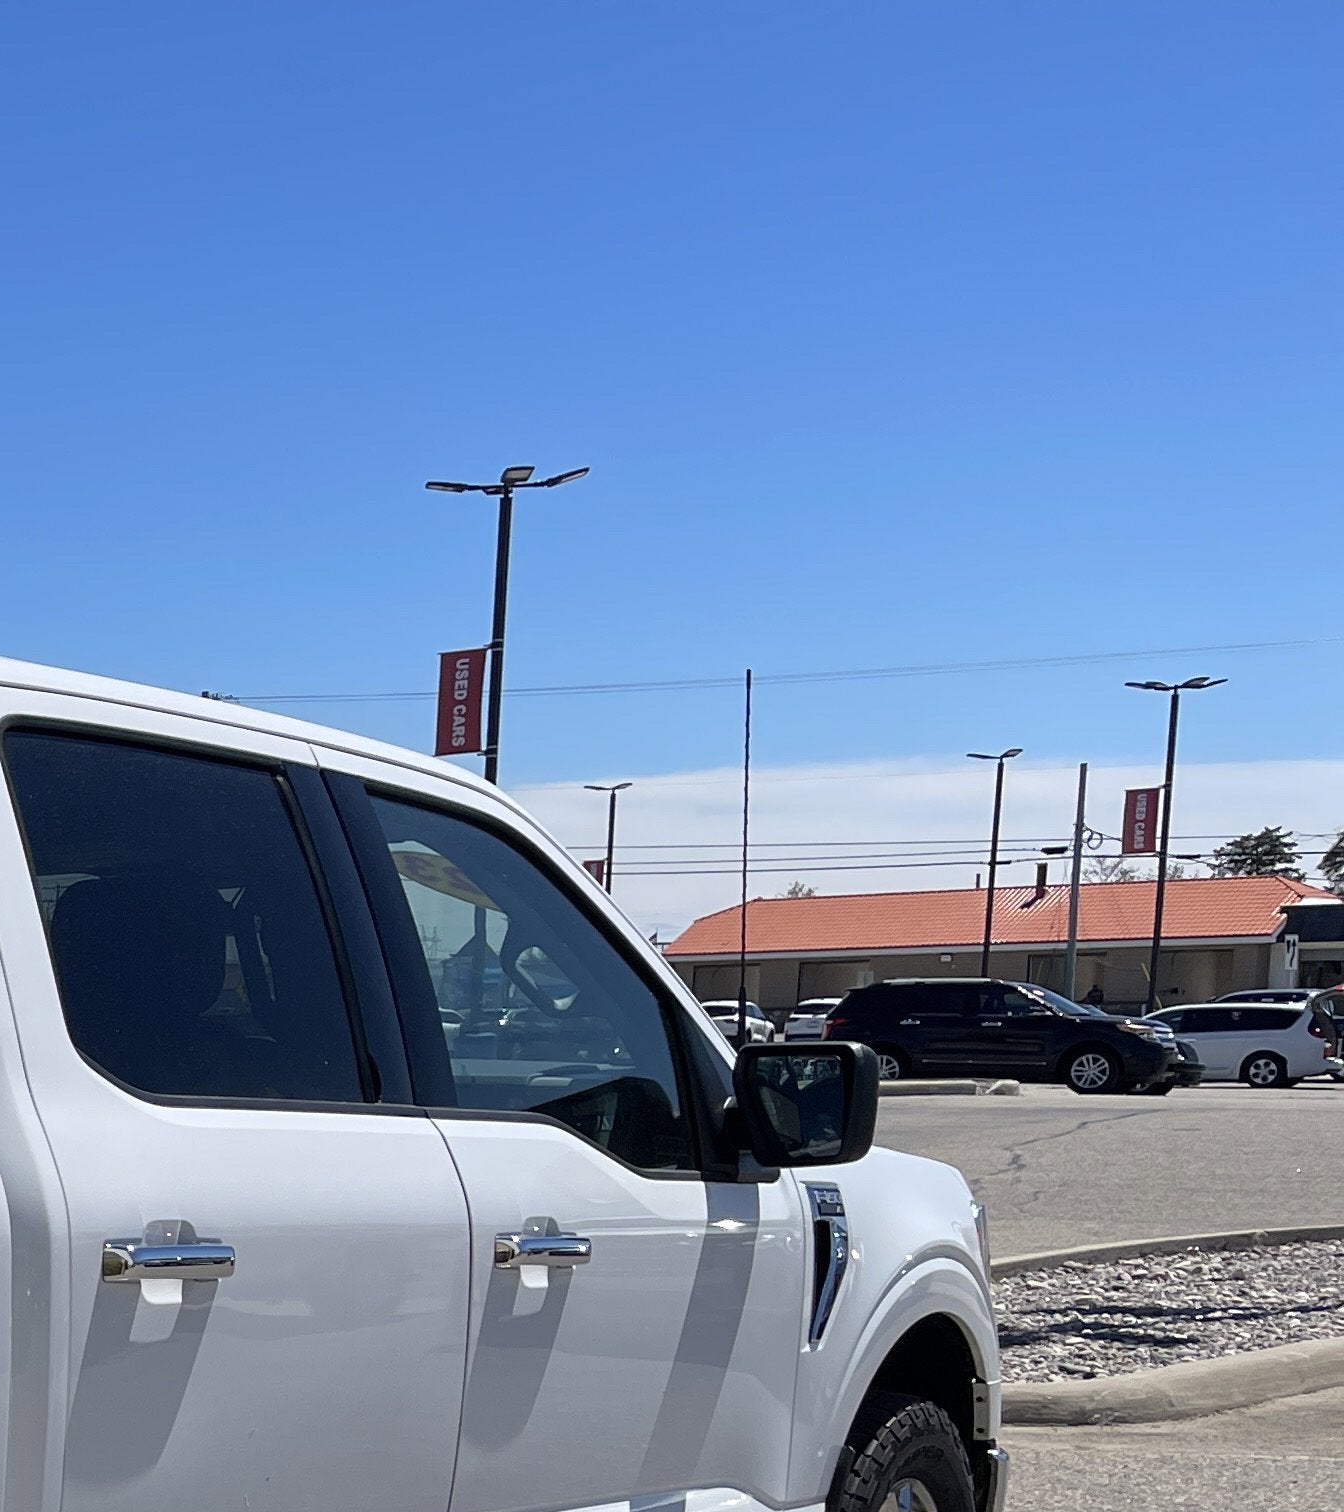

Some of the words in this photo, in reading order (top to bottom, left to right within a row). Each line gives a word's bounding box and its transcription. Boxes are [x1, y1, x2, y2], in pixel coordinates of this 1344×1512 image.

[454, 658, 471, 700] USED
[452, 704, 466, 747] CARS
[1136, 794, 1148, 820] USED
[1134, 822, 1145, 849] CARS
